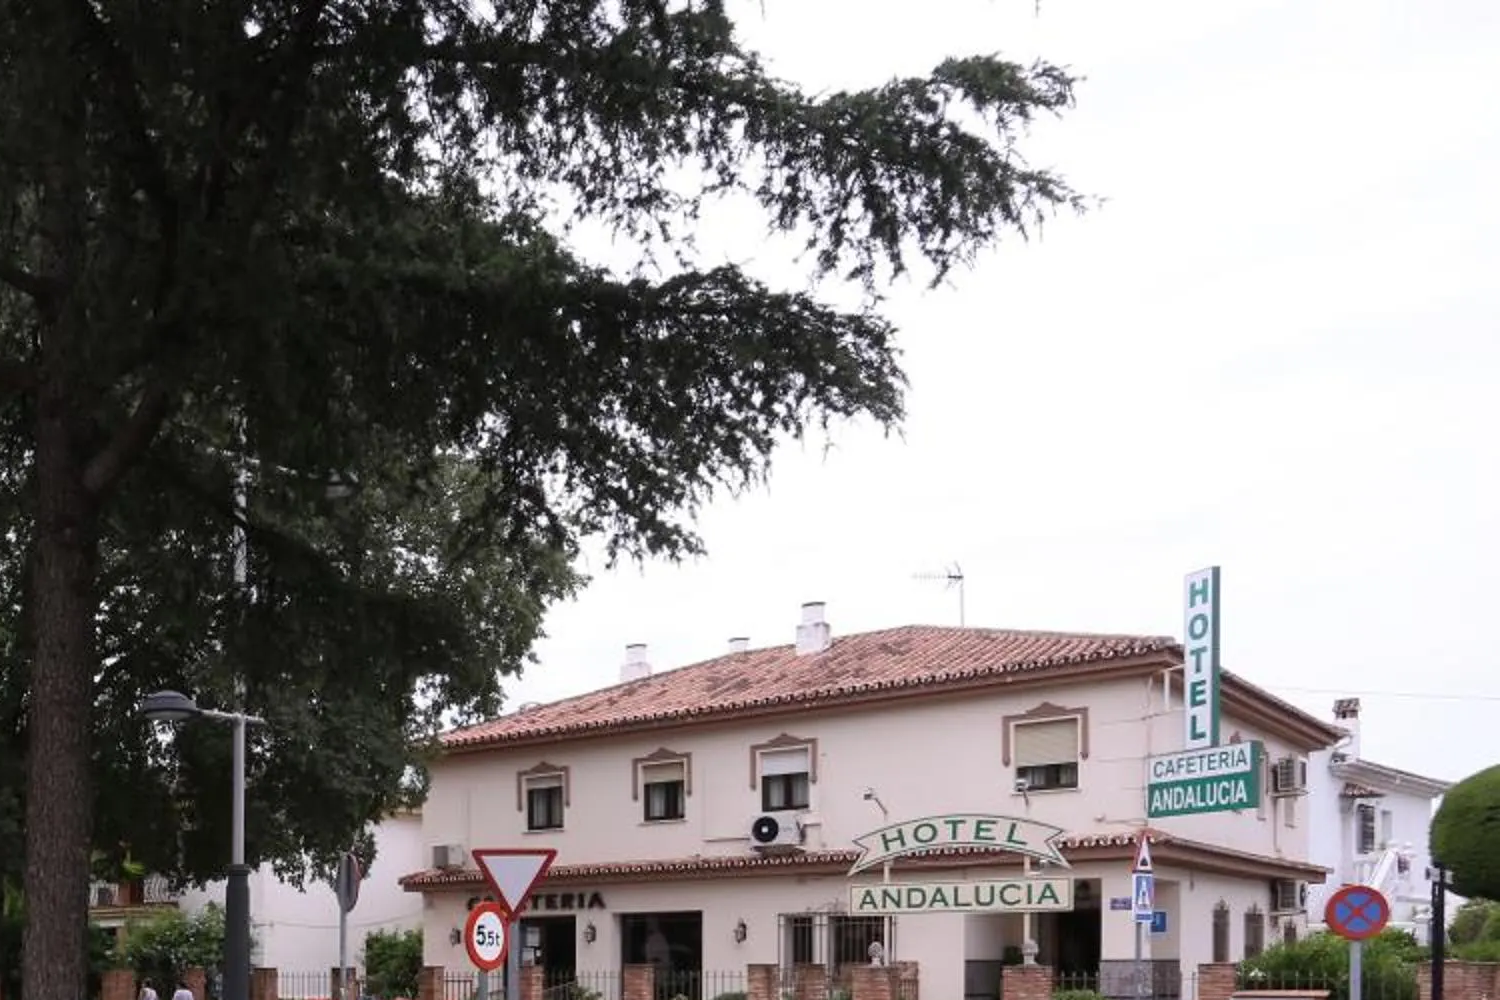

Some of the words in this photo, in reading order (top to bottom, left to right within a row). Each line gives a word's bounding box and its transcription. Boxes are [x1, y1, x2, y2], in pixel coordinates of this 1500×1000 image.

[1188, 578, 1209, 740] HOTEL
[1153, 748, 1248, 778] CAFETERIA
[1151, 780, 1247, 814] ANDALUCIA
[881, 819, 1028, 851] HOTEL
[467, 891, 606, 911] CTERIA
[859, 883, 1060, 910] ANDALUCIA
